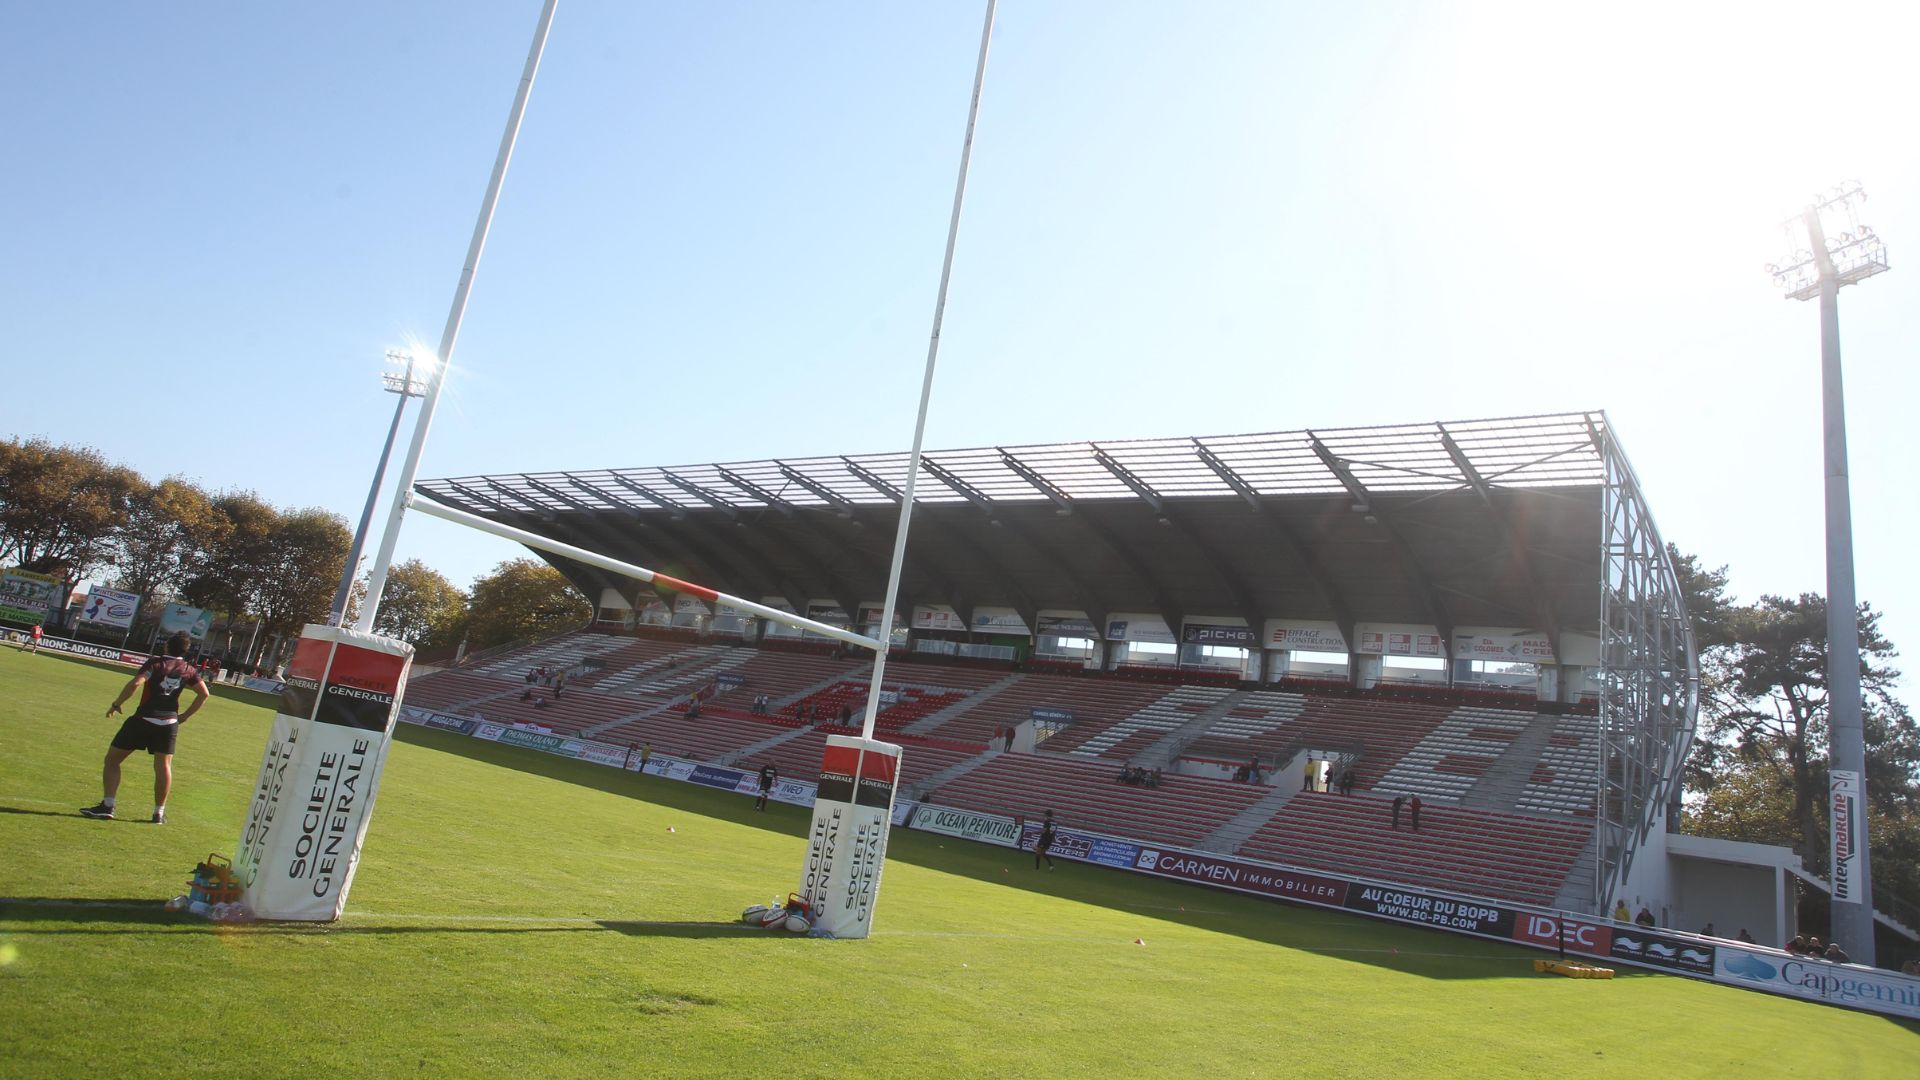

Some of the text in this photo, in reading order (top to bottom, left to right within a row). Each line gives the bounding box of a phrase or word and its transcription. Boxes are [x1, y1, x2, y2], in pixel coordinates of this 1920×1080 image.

[16, 633, 120, 660] MAARONS-ADAM.COM
[287, 677, 319, 690] GENERALE
[328, 686, 393, 704] GENERALE
[781, 783, 803, 795] INEO
[820, 773, 853, 783] GENERALE
[861, 779, 892, 790] GENERALE
[240, 739, 280, 866] SOCIETE
[246, 726, 299, 889] GENERALE
[289, 751, 337, 879] SOCIETE
[312, 738, 370, 898] GENERALE
[935, 811, 1020, 840] OCEAN PEINTURE
[805, 816, 827, 902] SOCIETE
[815, 807, 842, 918] GENERALE
[845, 823, 867, 910] SOCIETE
[857, 814, 882, 922] GENERALE
[1160, 856, 1336, 897] CARMEN IMMOBILIER
[1361, 888, 1499, 922] AU COEUR DU BOPB
[1376, 903, 1477, 930] WWW.BO-PB.COM
[1528, 915, 1597, 946] IDEC
[1781, 961, 1920, 1007] Capgemi
